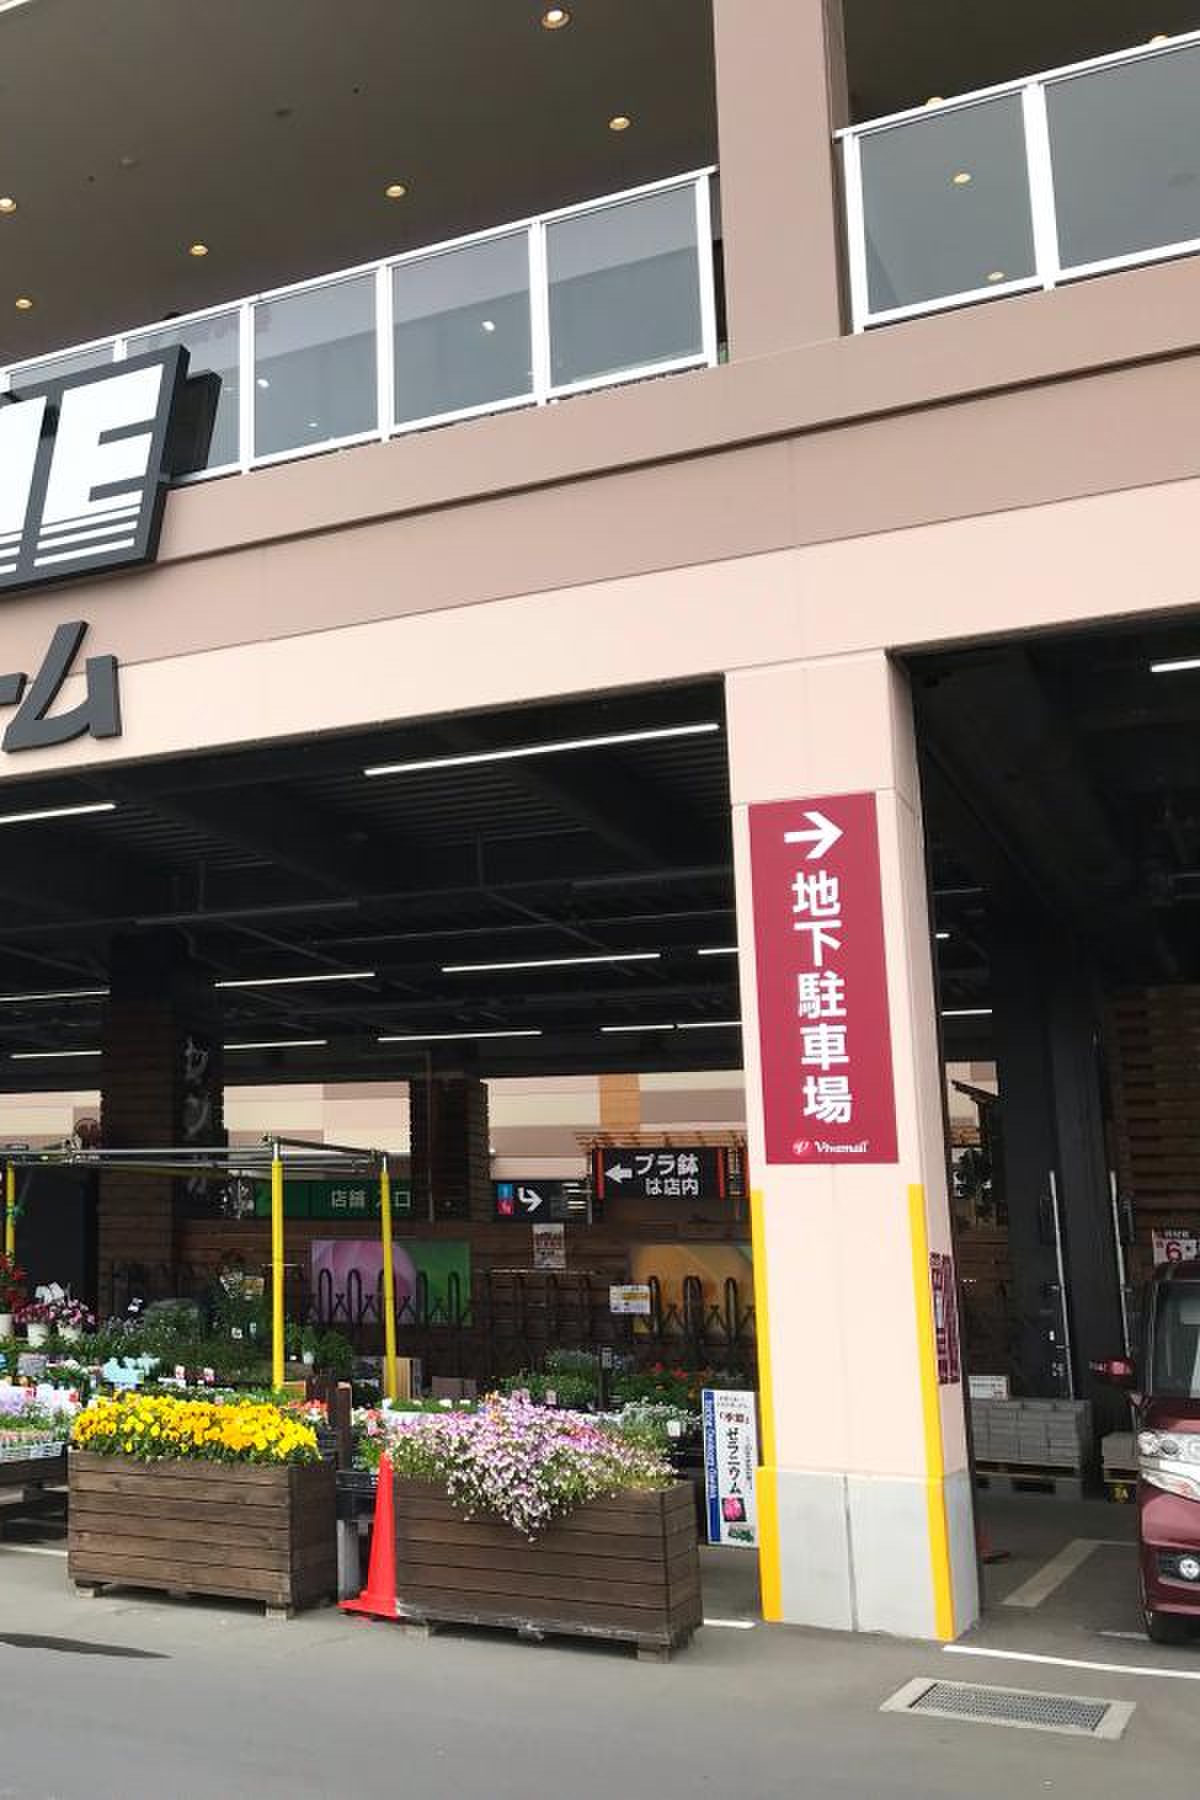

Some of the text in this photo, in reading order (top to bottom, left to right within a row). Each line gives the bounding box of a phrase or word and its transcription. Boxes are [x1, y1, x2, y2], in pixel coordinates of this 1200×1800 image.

[790, 870, 853, 1125] 地下駐車場
[635, 1152, 699, 1176] プラ鉢
[645, 1177, 699, 1196] は店内
[331, 1190, 411, 1208] 店舗口
[726, 1427, 742, 1495] ゼラニウム
